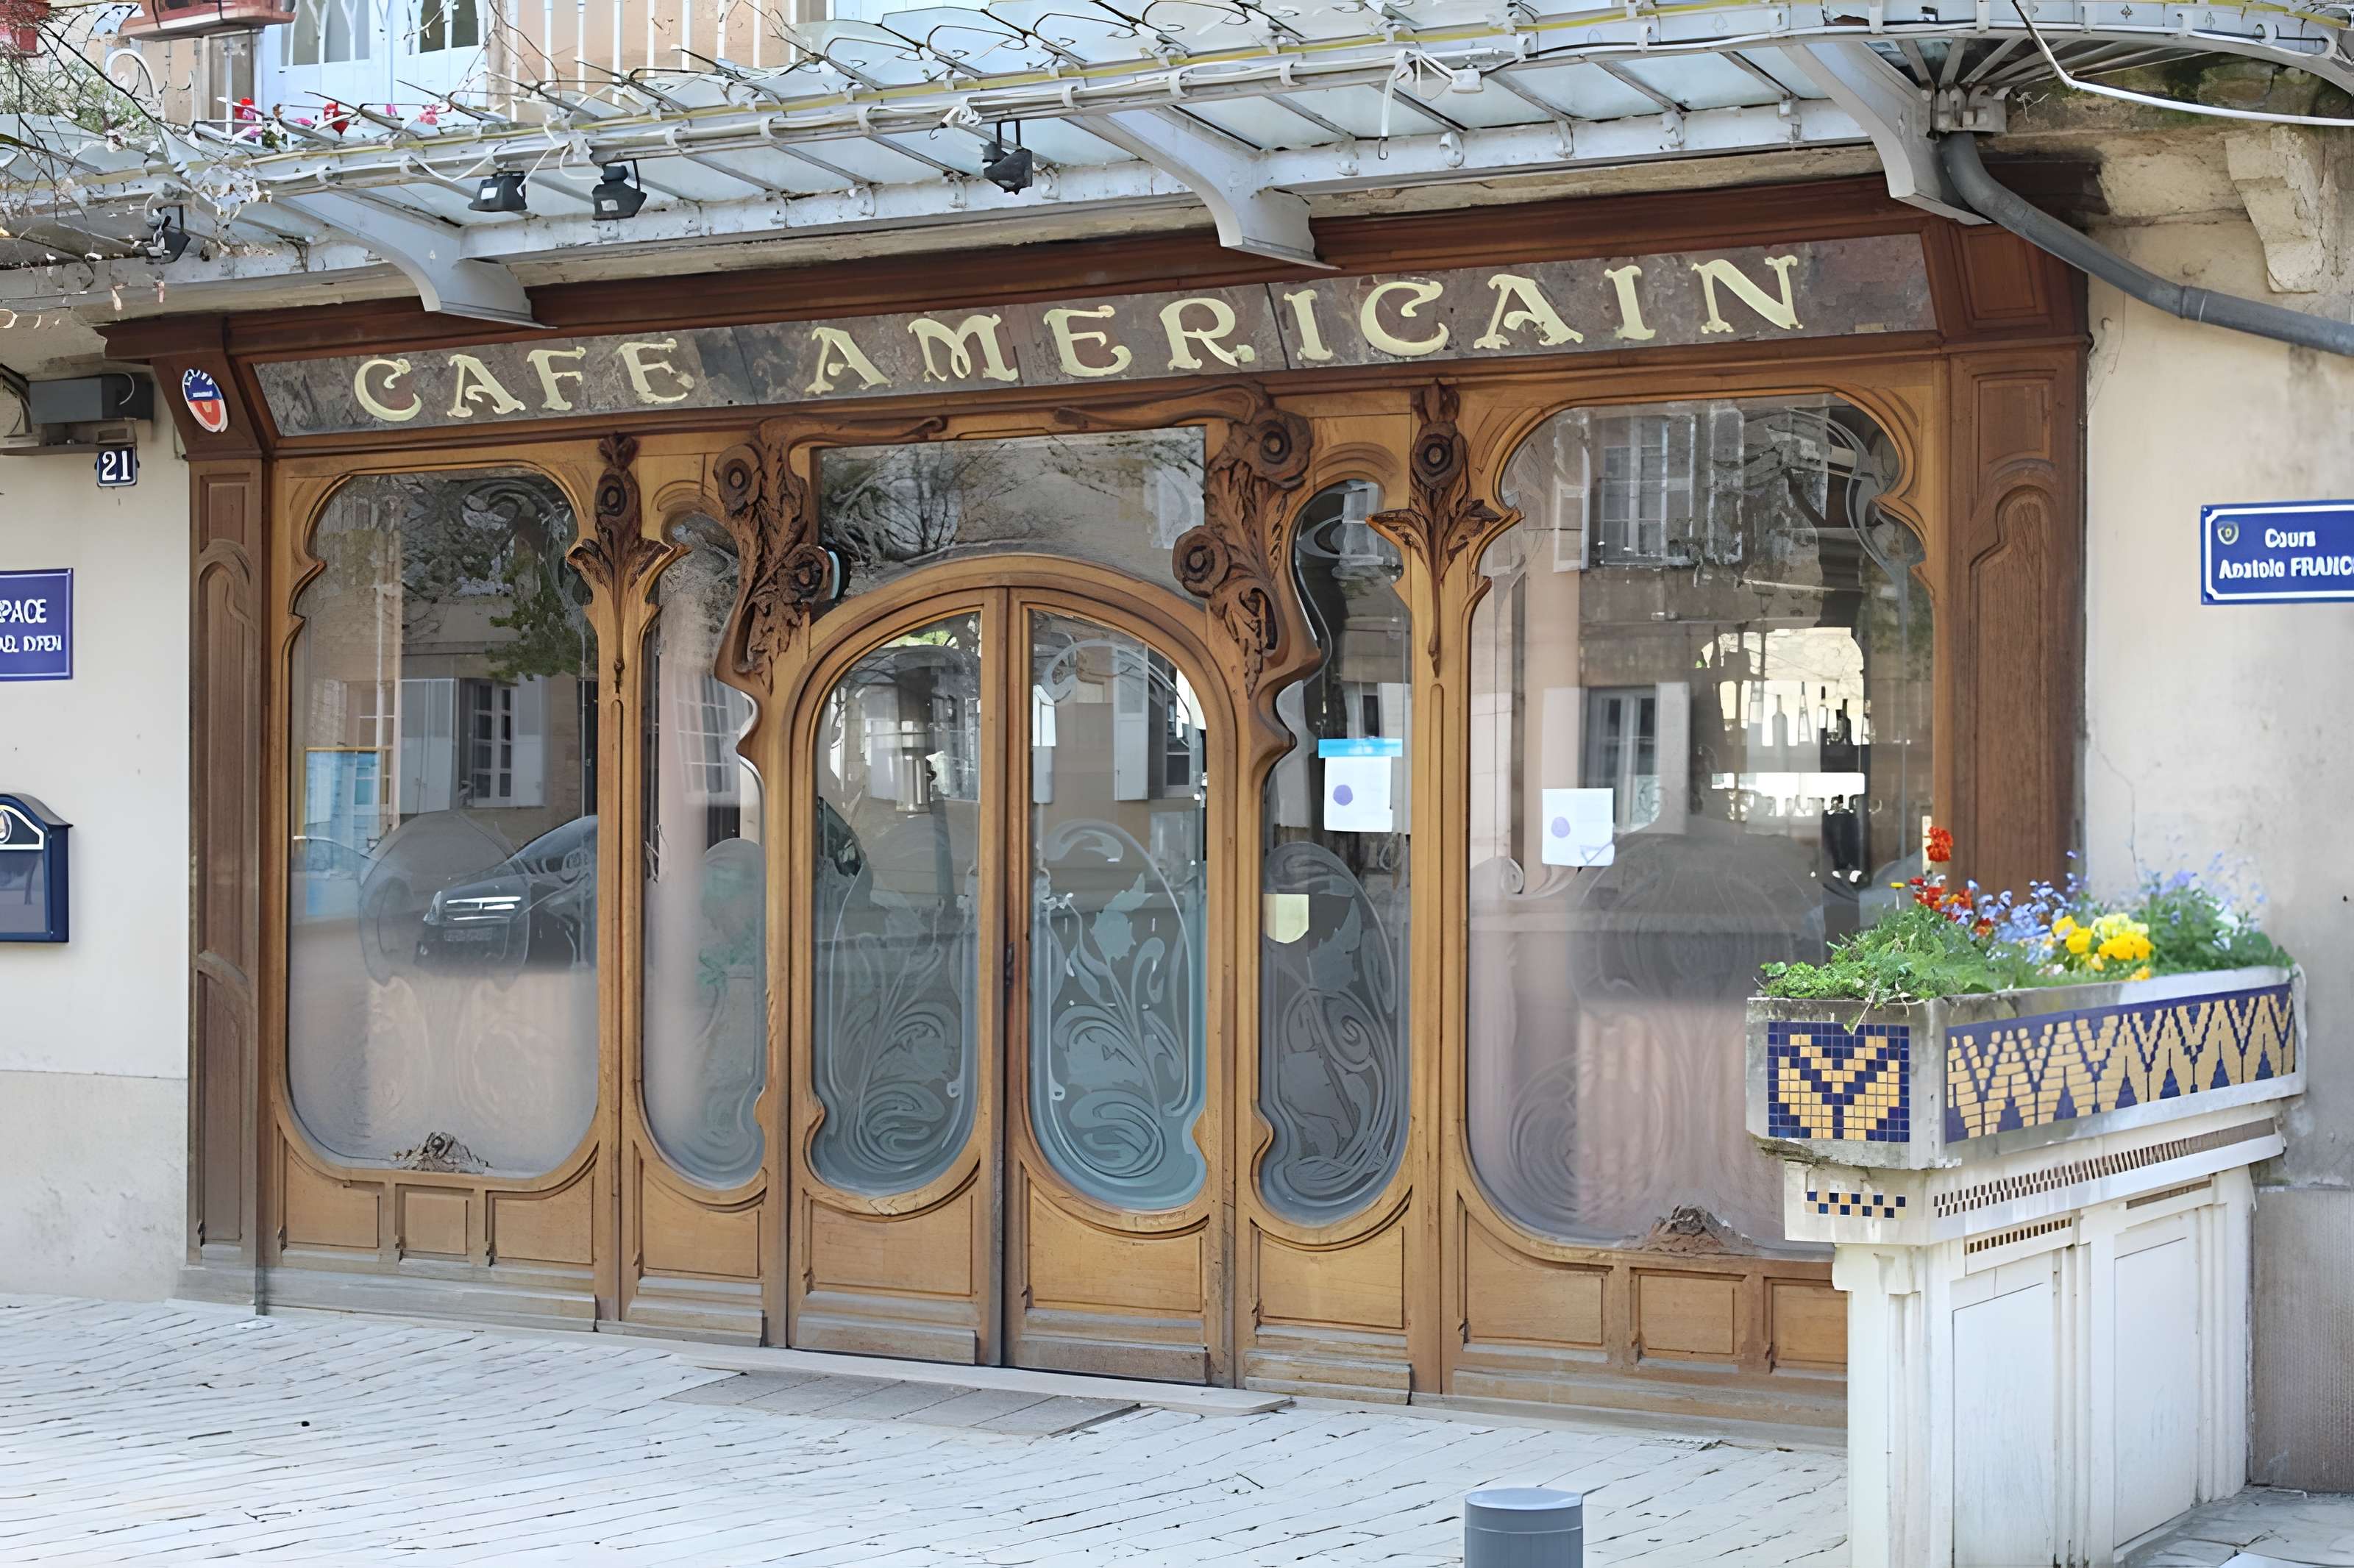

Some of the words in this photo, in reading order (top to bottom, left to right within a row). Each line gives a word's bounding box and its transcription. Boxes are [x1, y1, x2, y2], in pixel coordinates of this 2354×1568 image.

[354, 338, 695, 421] CAFE
[804, 254, 1804, 395] AMERICAIN
[102, 450, 131, 481] 21
[2290, 555, 2354, 577] FRANC
